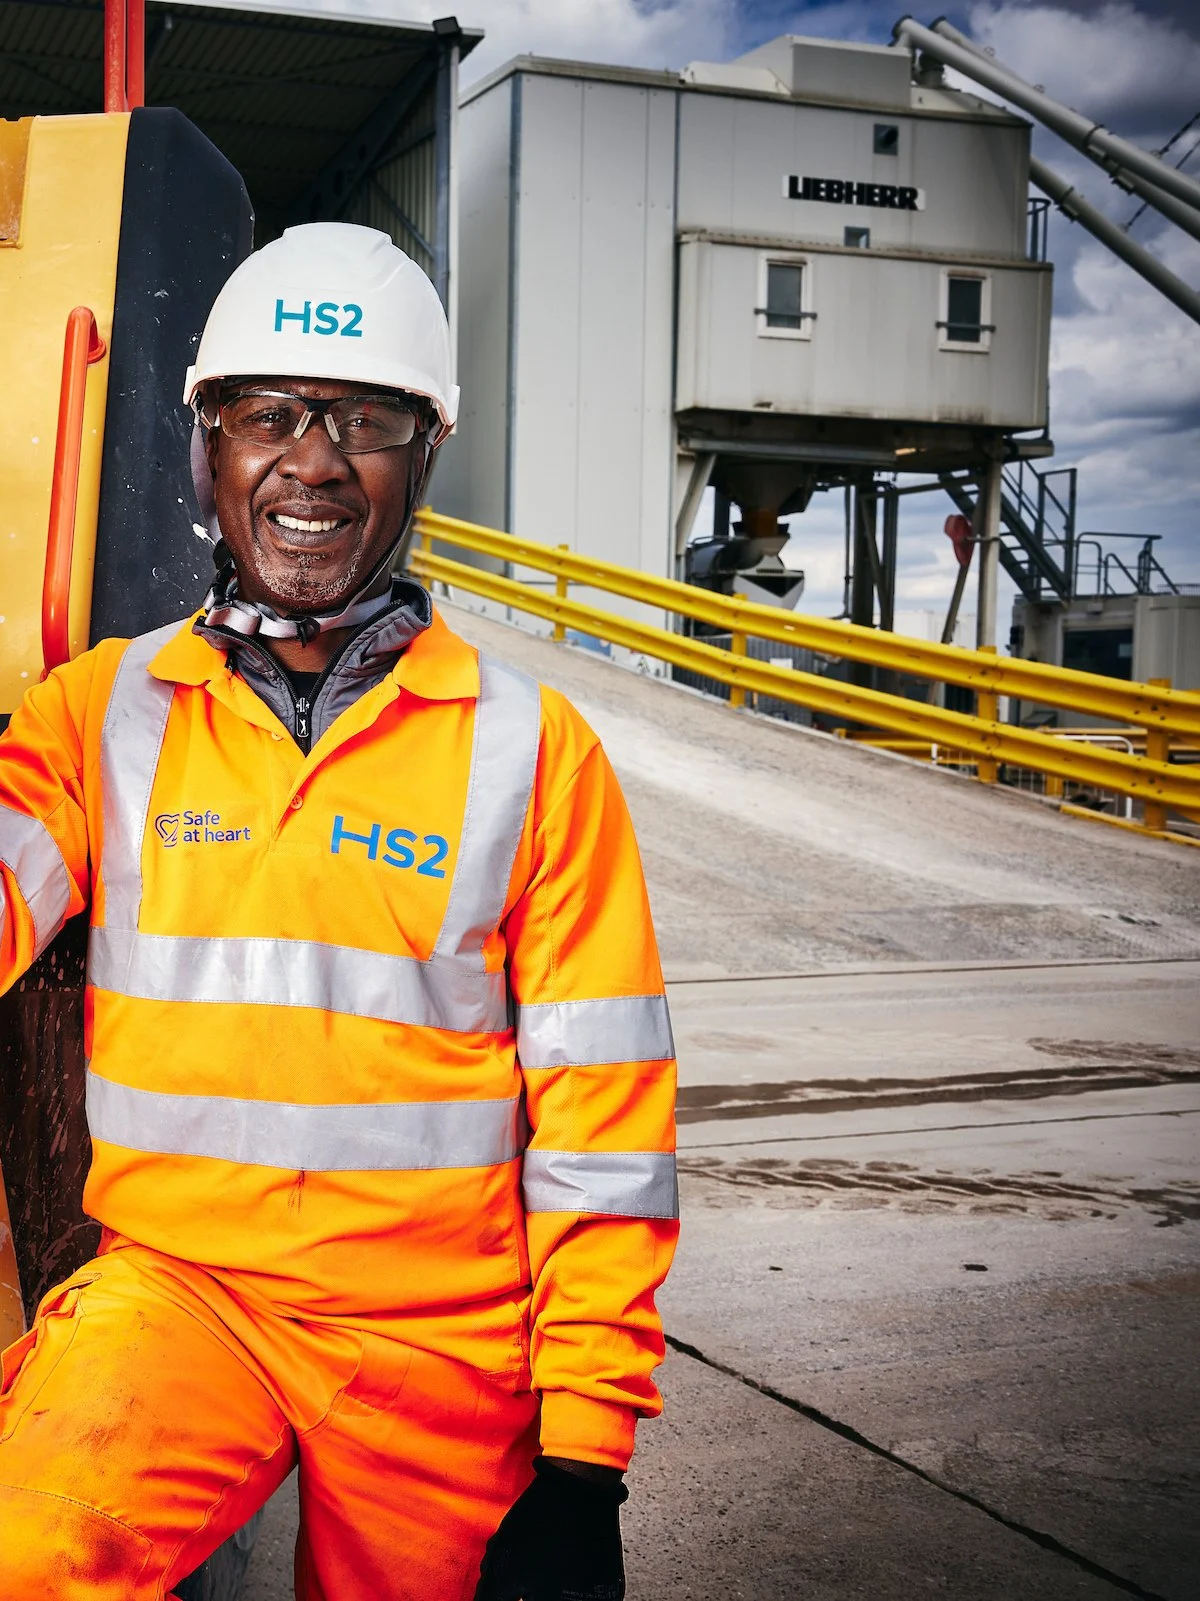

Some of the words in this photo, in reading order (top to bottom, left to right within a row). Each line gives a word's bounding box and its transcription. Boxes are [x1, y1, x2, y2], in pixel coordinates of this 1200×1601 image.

[788, 175, 919, 211] LIEBHERR
[274, 299, 363, 337] HS2
[183, 810, 220, 827] Safe
[183, 828, 203, 843] at
[205, 826, 251, 842] heart
[330, 815, 449, 879] HS2
